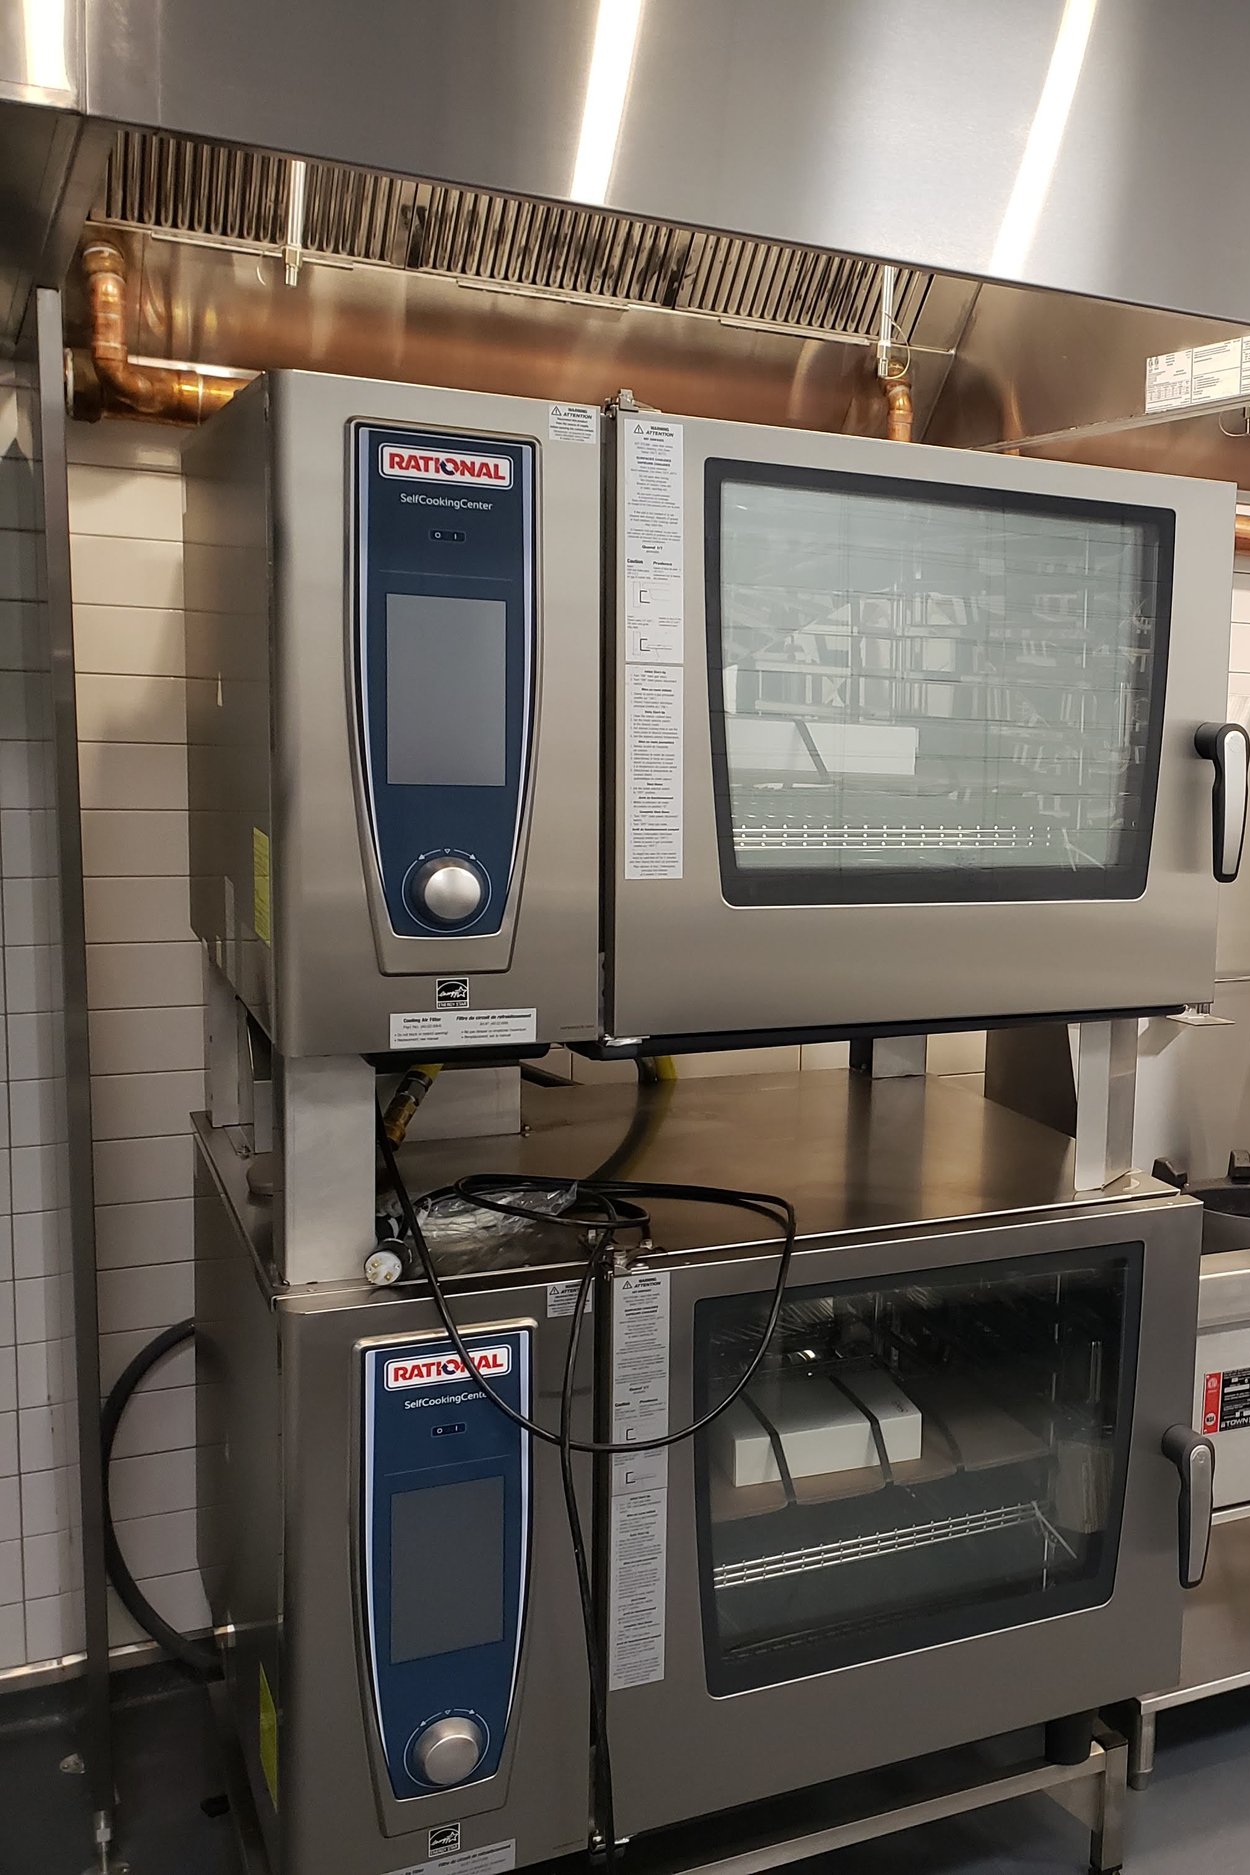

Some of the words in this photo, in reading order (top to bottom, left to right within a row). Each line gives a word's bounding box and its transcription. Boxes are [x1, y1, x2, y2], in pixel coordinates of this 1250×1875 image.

[388, 452, 506, 480] RATIONAL
[400, 493, 493, 511] SelfCookingCenter
[393, 1354, 504, 1382] RATIOAL
